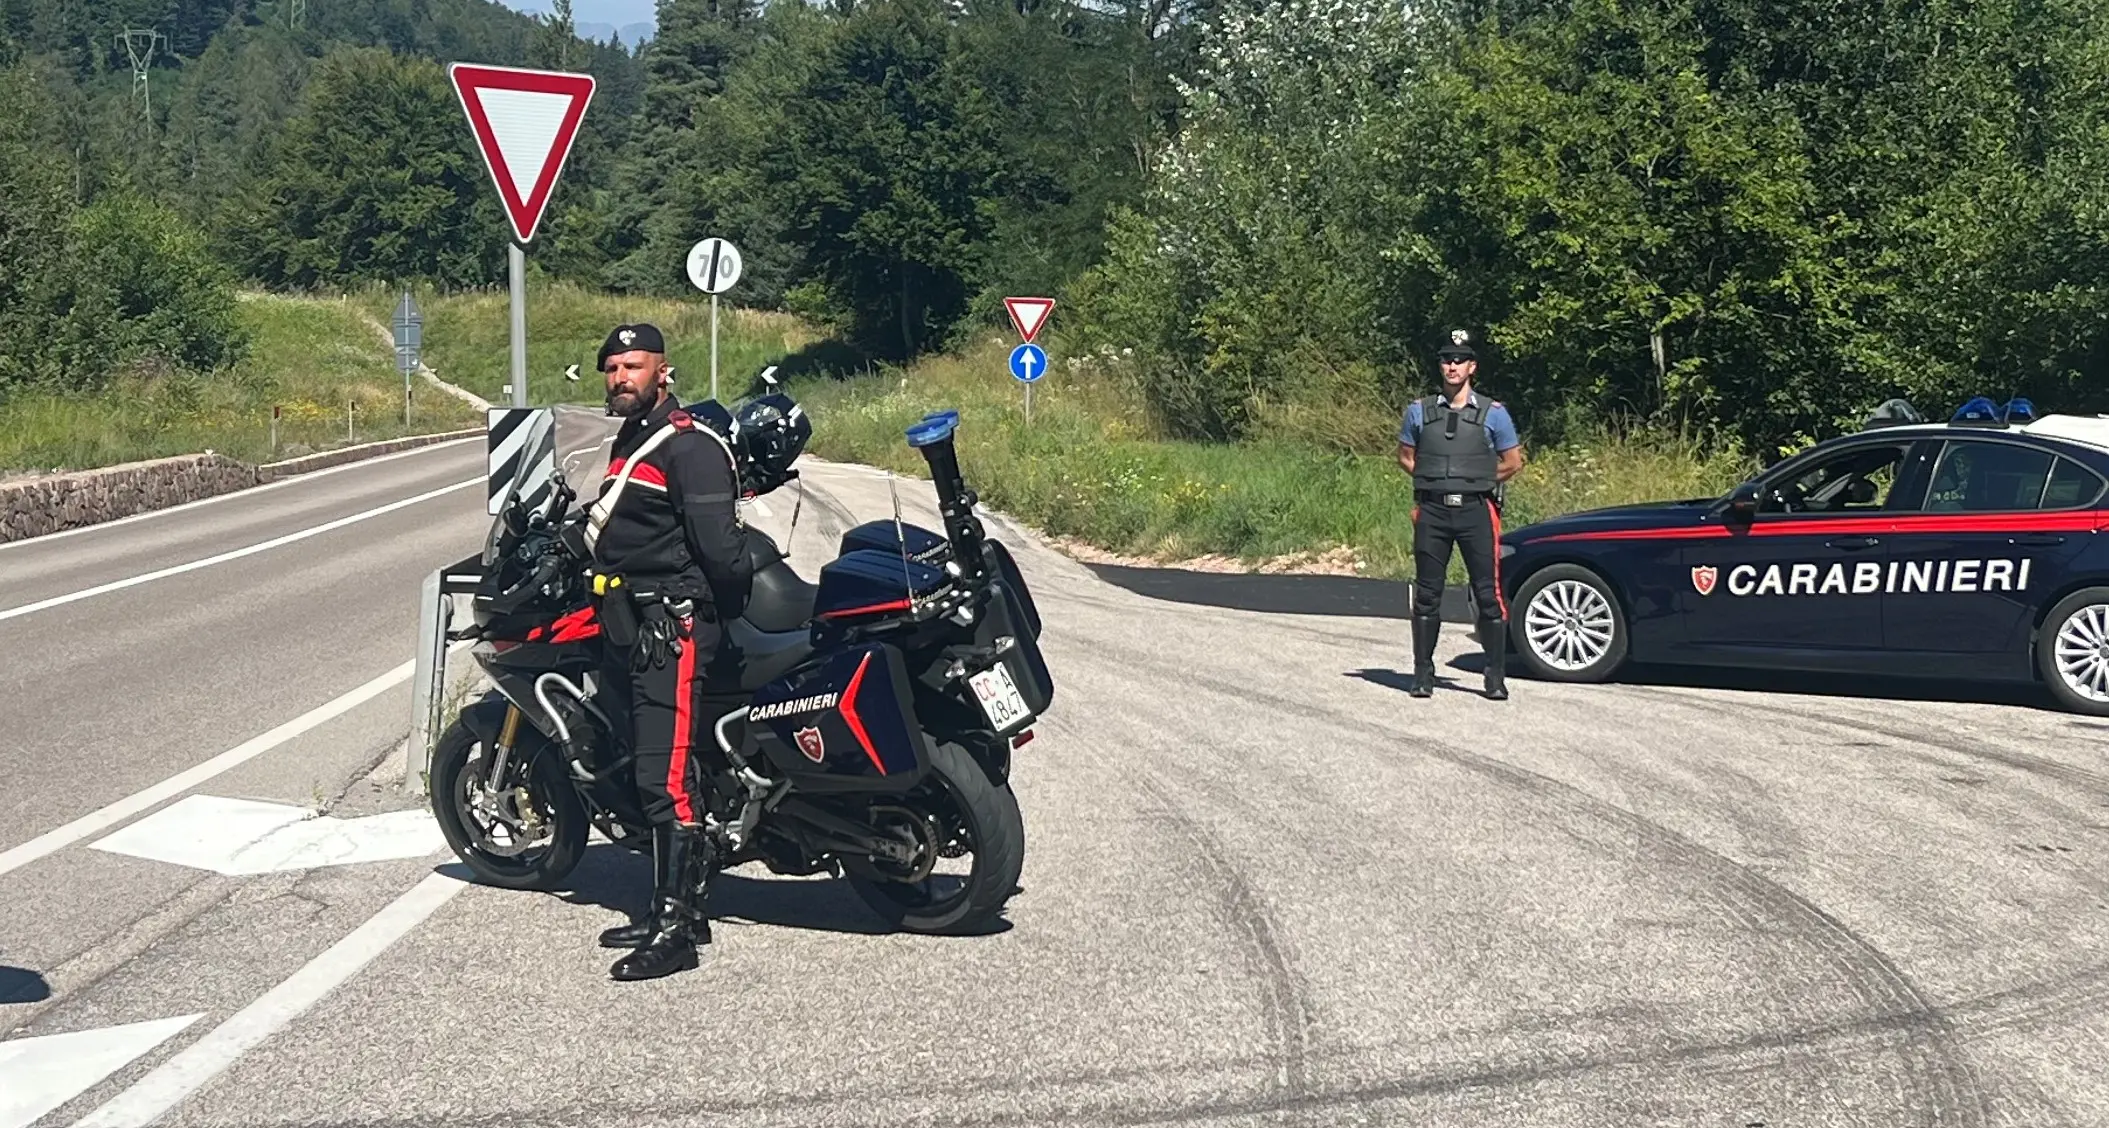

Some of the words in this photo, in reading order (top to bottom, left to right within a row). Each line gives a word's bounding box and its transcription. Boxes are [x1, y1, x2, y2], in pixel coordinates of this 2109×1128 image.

[699, 254, 734, 278] 70
[1728, 558, 2031, 596] CARABINIERI
[975, 677, 996, 701] CC
[998, 668, 1013, 689] A
[749, 692, 838, 722] CARABINIERI
[991, 691, 1023, 724] 4847
